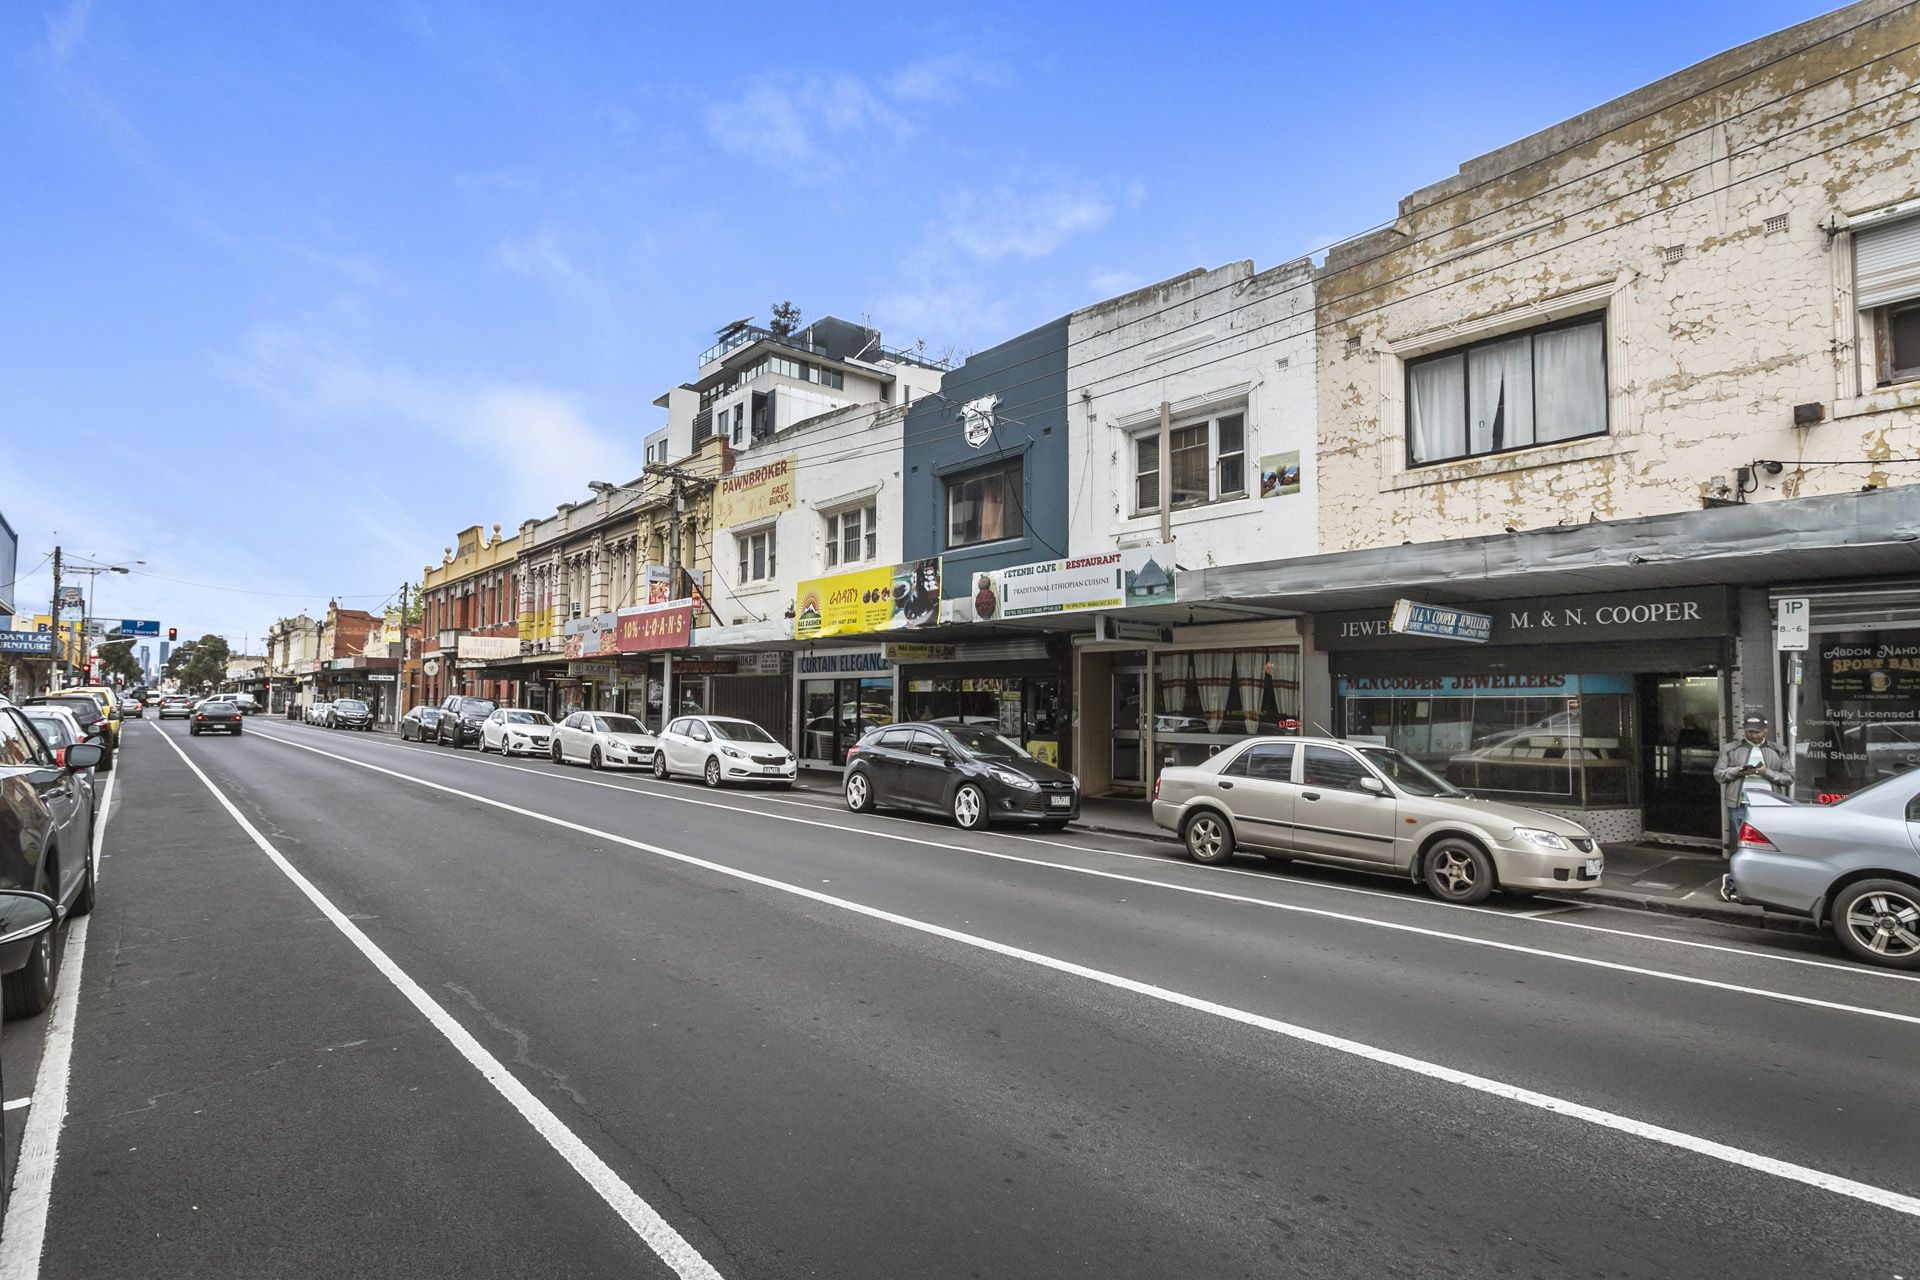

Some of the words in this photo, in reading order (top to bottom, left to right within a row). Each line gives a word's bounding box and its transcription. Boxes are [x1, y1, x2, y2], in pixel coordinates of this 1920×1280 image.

[722, 460, 788, 495] PAWNBROKER
[771, 483, 789, 496] FAST
[769, 492, 789, 506] BUCKS
[1003, 566, 1035, 579] YETENBI
[1036, 563, 1057, 574] CAFE
[1065, 554, 1122, 570] RESTAURANT
[1013, 584, 1050, 596] TRADITIONAL
[1051, 581, 1084, 591] ETHIOPIAN
[1085, 577, 1110, 588] CUISINE
[1510, 612, 1534, 629] M.
[1541, 610, 1556, 627] &
[1564, 608, 1587, 626] N.
[1595, 601, 1702, 625] COOPER
[1785, 602, 1803, 614] 1P
[37, 622, 70, 633] Beta
[1423, 624, 1438, 632] WATCH
[1432, 611, 1457, 626] COOPER
[1458, 614, 1490, 630] JEWELLERS
[623, 621, 638, 639] 10%
[1823, 646, 1871, 659] ABDON
[1877, 645, 1920, 658] NAHD
[801, 656, 837, 673] CURTAIN
[840, 653, 889, 672] ELEGANCE
[1832, 658, 1885, 674] SPORT
[1451, 673, 1566, 689] JEWELLERS
[1826, 709, 1854, 719] Fully
[1857, 709, 1914, 719] Licensed
[1805, 719, 1840, 727] Opening
[1831, 751, 1868, 761] Shake
